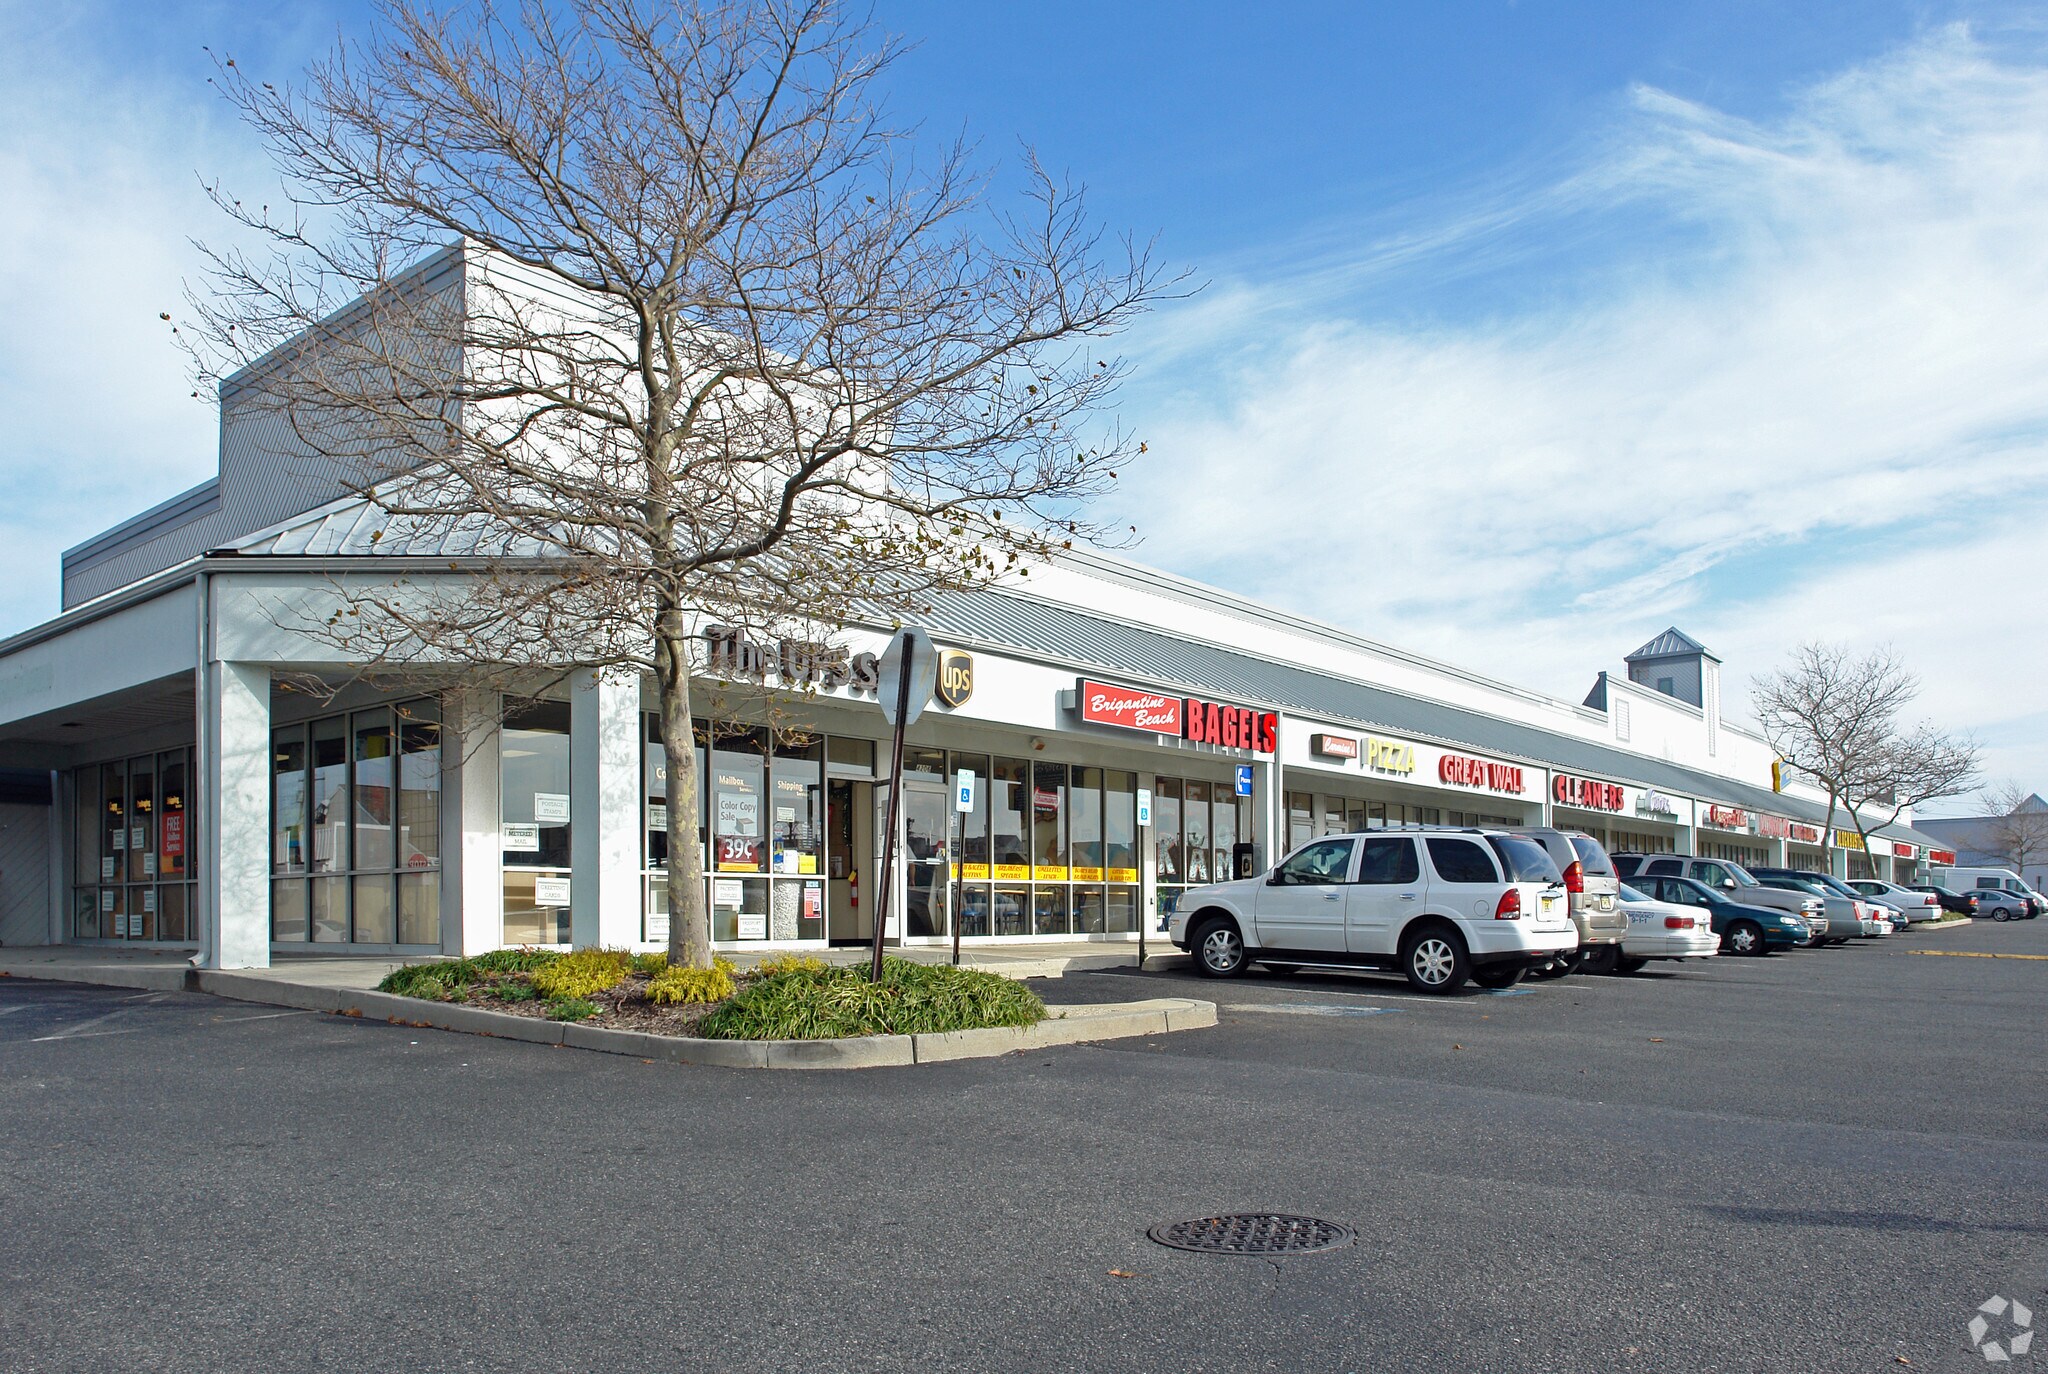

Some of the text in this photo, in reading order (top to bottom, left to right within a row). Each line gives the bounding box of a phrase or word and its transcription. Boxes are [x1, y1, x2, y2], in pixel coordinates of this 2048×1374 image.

[706, 624, 777, 675] The
[943, 664, 970, 697] ups
[1091, 694, 1165, 720] Brigantine
[1135, 709, 1175, 727] Beach
[1187, 699, 1278, 753] BAGELS
[1367, 737, 1415, 773] PIZZA
[719, 775, 745, 786] Mailbox
[1442, 755, 1526, 792] GREAT WALL
[777, 780, 803, 792] Shipping
[1555, 774, 1624, 811] CLEANERS
[720, 800, 757, 813] Color Copy
[720, 811, 736, 821] Sale
[167, 816, 180, 831] FREE
[724, 838, 753, 859] 39¢
